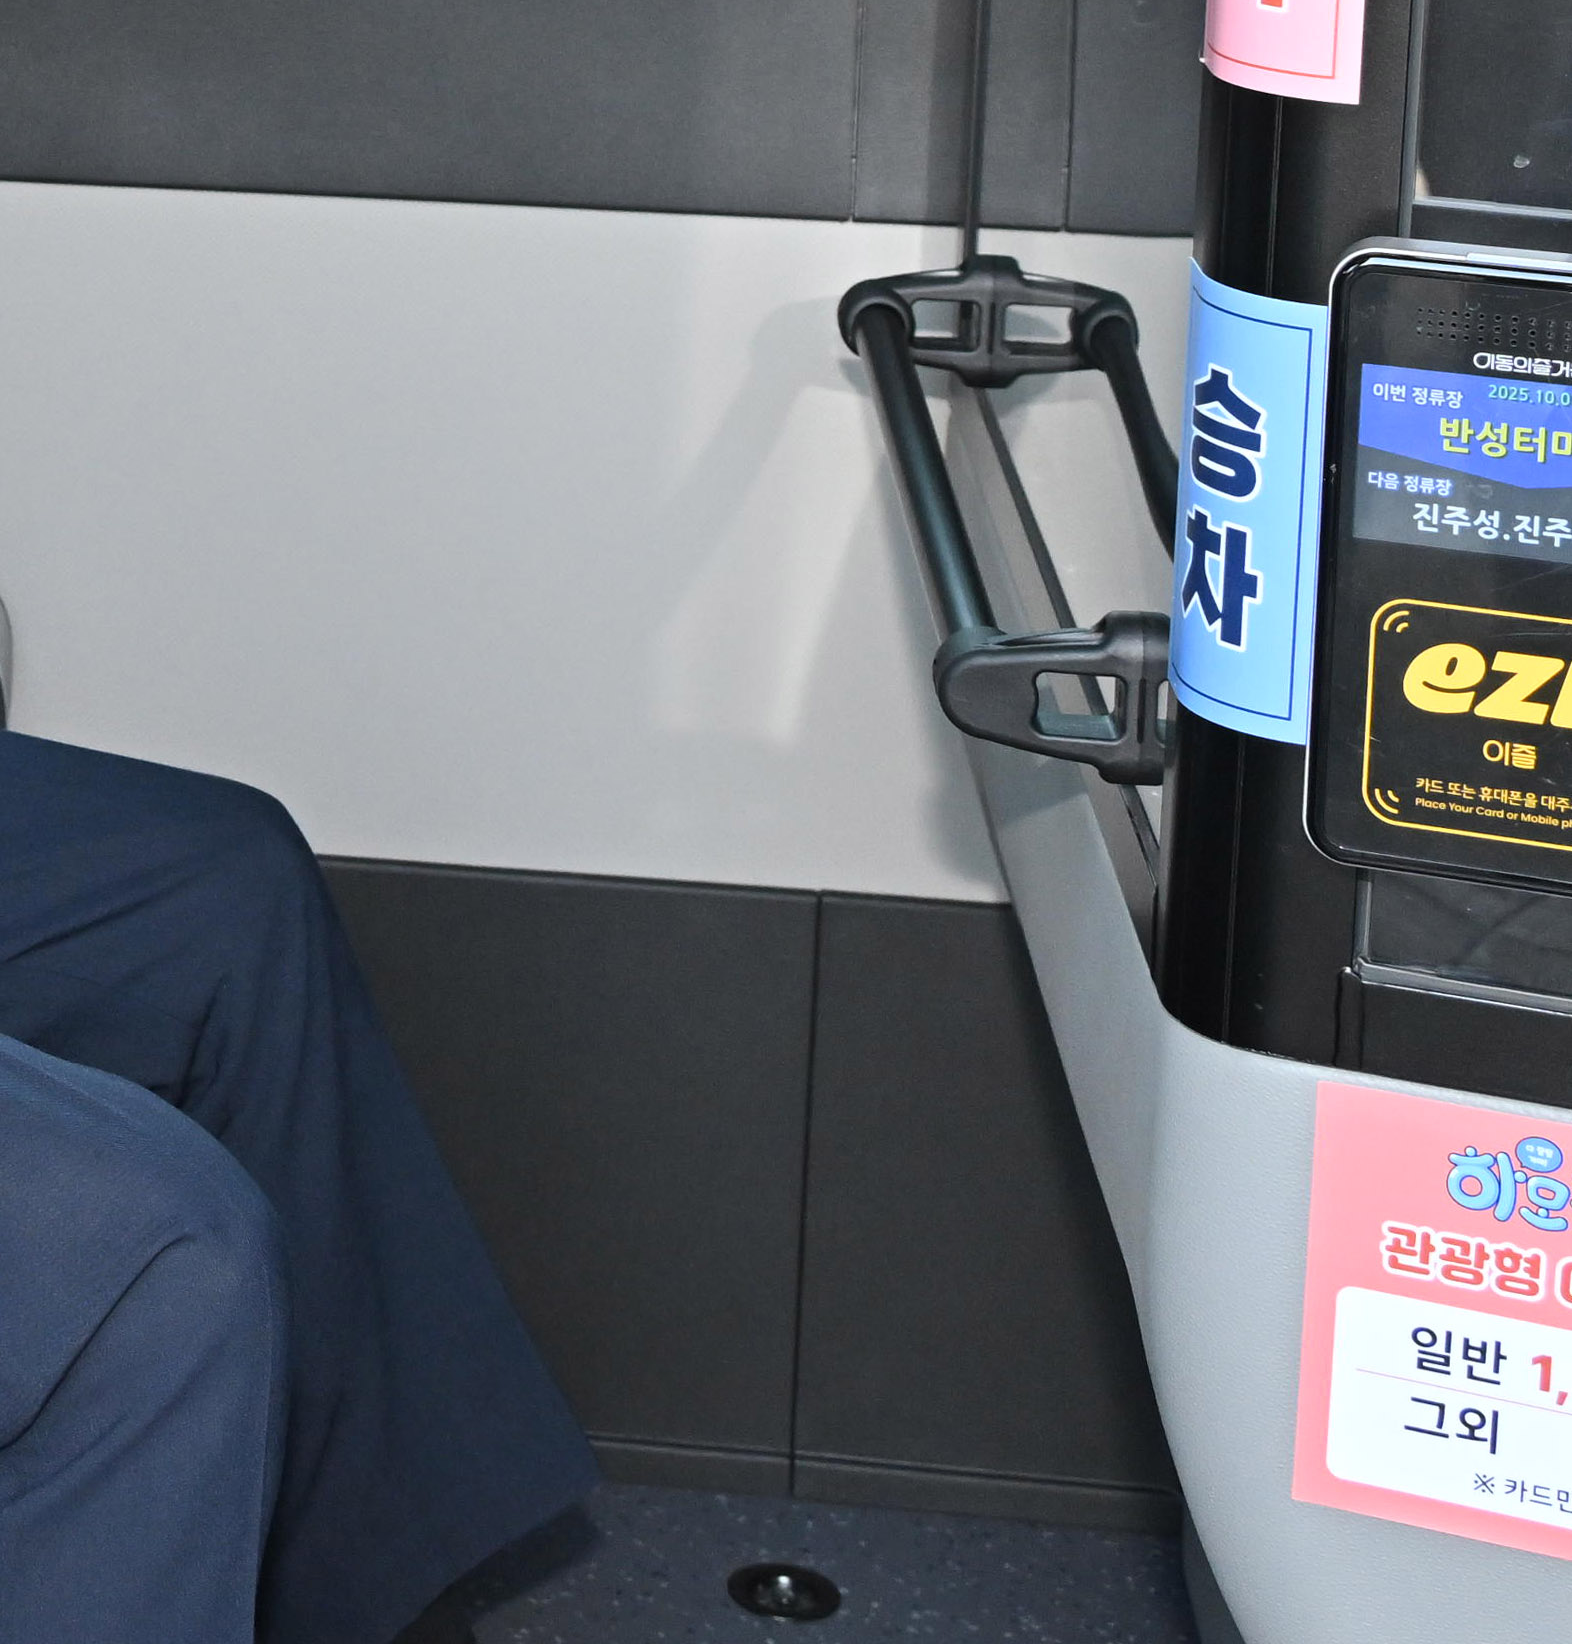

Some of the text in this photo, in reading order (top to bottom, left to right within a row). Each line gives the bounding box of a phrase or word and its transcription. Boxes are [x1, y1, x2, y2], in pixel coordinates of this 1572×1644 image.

[1472, 352, 1572, 379] 이동의즐거
[1372, 382, 1464, 409] 이번 정류장
[1368, 471, 1453, 497] 다음 정류장
[1181, 367, 1263, 649] 승차
[1482, 739, 1538, 770] 이즐
[1415, 777, 1572, 814] 카드 또는 휴대폰을 대주
[1415, 796, 1447, 810] Place
[1448, 802, 1475, 815] Your
[1475, 805, 1505, 819] Card
[1506, 811, 1520, 821] or
[1520, 811, 1559, 828] Mobile
[1384, 1225, 1543, 1297] 관광형
[1410, 1326, 1508, 1386] 일반
